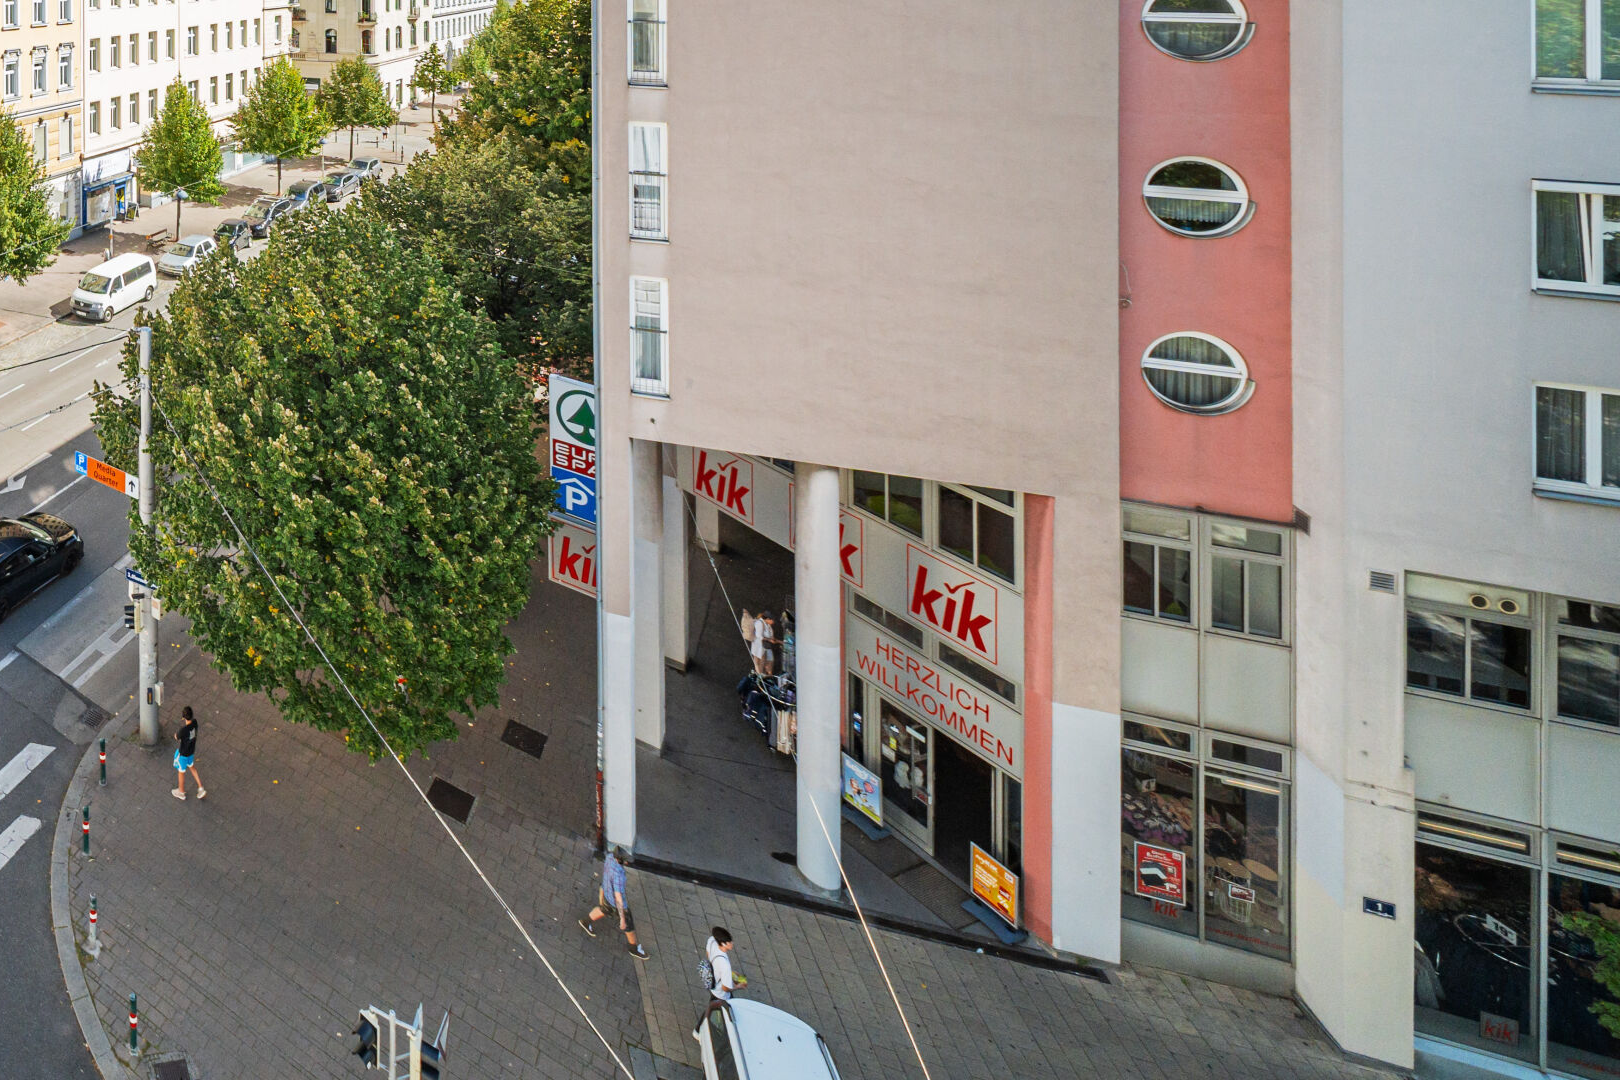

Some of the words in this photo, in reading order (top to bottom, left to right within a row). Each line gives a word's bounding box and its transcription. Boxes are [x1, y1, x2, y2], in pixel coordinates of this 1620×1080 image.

[93, 470, 118, 488] Quarter
[96, 462, 116, 477] Media
[696, 449, 750, 517] kik
[565, 484, 588, 511] P
[558, 535, 596, 587] ki
[910, 564, 992, 653] kik
[876, 637, 990, 723] HERZLICH
[856, 650, 1013, 766] WILLKOMMEN
[1485, 1020, 1515, 1042] kik
